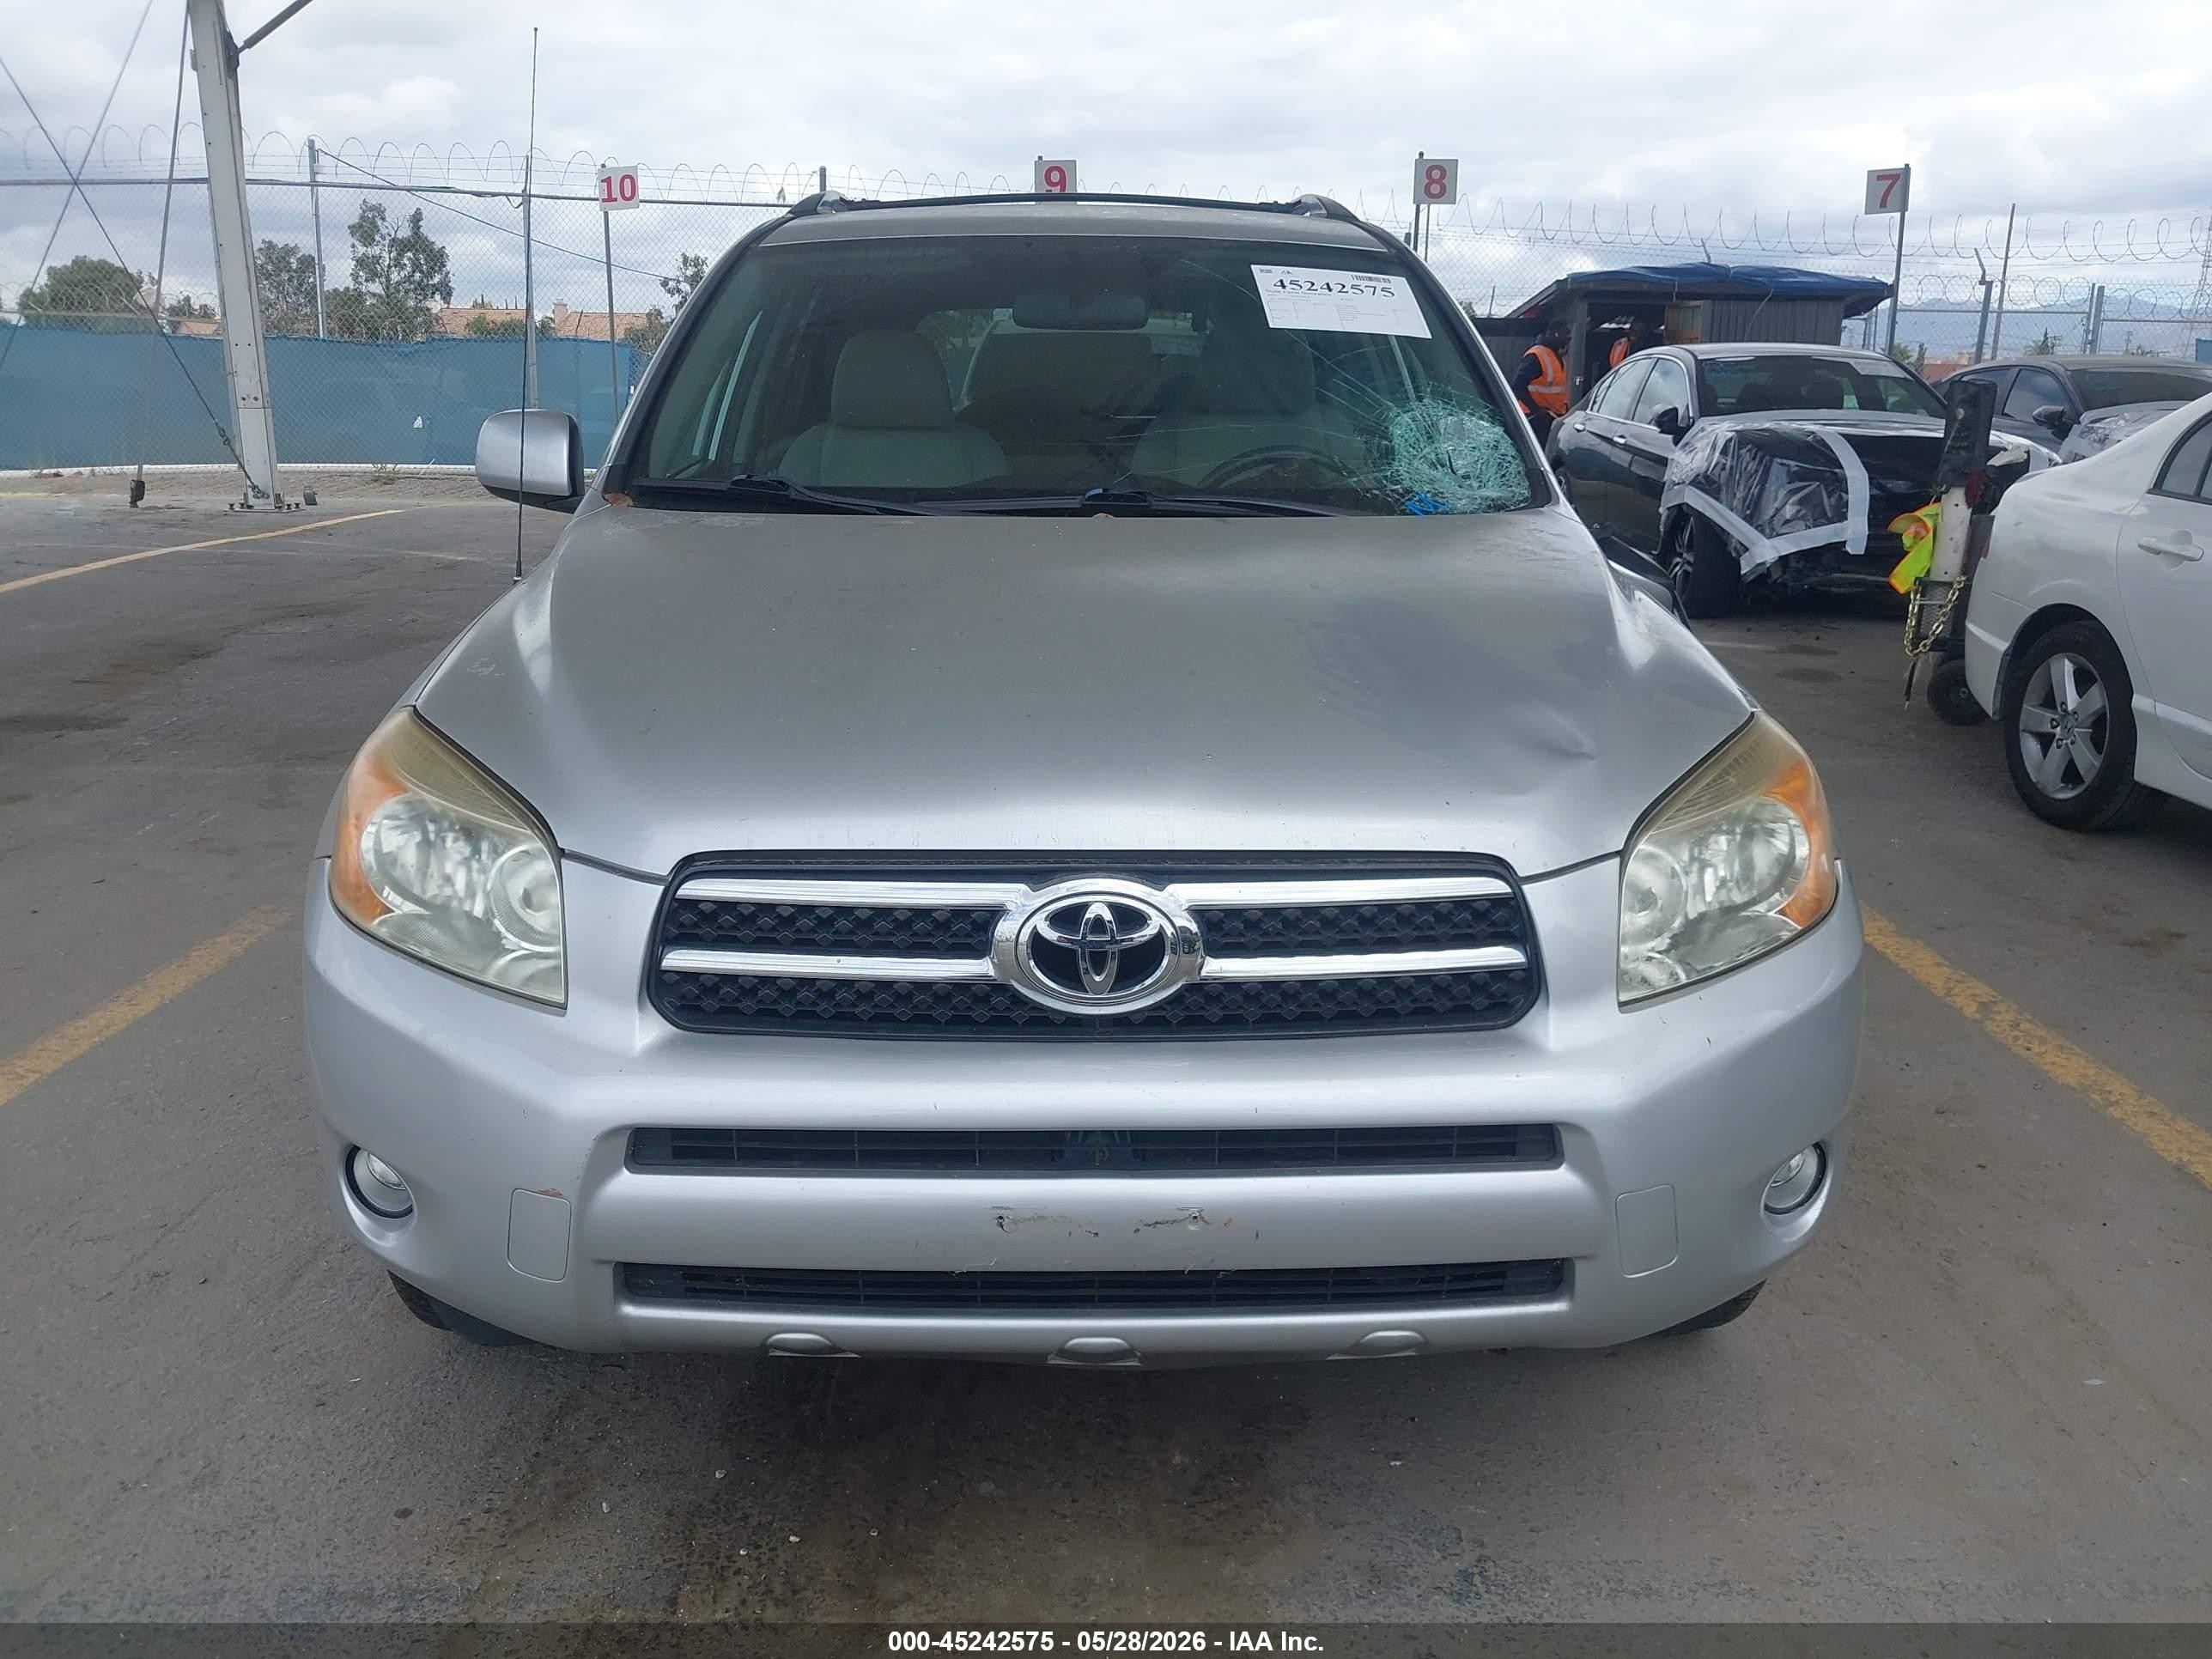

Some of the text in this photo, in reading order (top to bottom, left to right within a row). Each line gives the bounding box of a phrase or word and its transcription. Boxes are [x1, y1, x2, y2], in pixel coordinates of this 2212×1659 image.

[601, 174, 636, 203] 10
[1044, 166, 1066, 192] 9
[1424, 165, 1447, 199] 8
[1876, 173, 1901, 209] 7
[1273, 278, 1395, 298] 45242575
